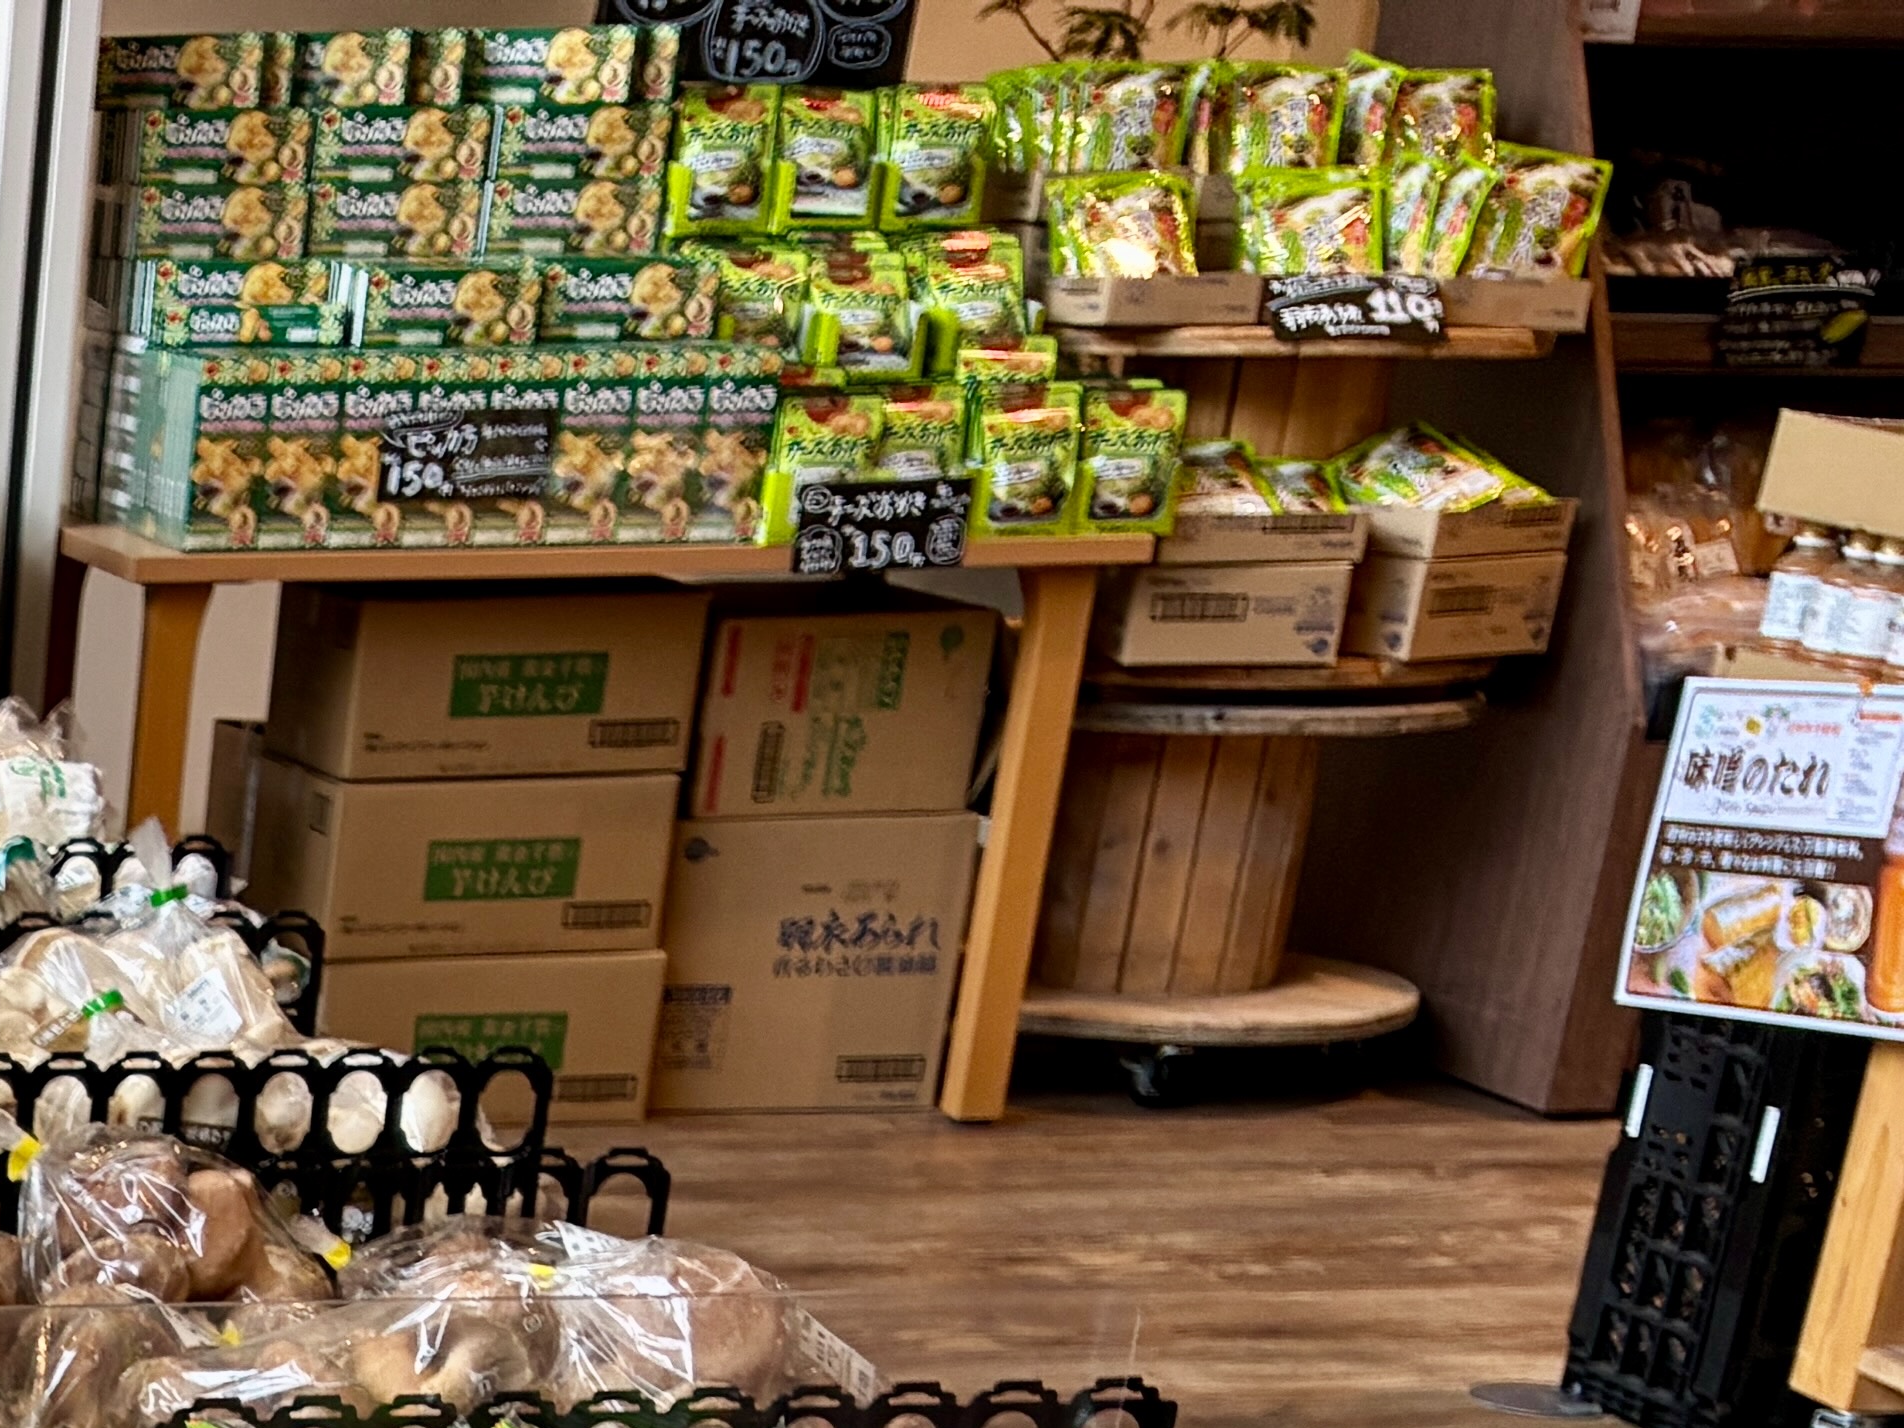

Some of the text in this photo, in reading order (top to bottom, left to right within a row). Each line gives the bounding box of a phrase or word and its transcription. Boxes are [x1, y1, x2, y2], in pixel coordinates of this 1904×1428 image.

[1685, 745, 1830, 798] 味噌のたれ
